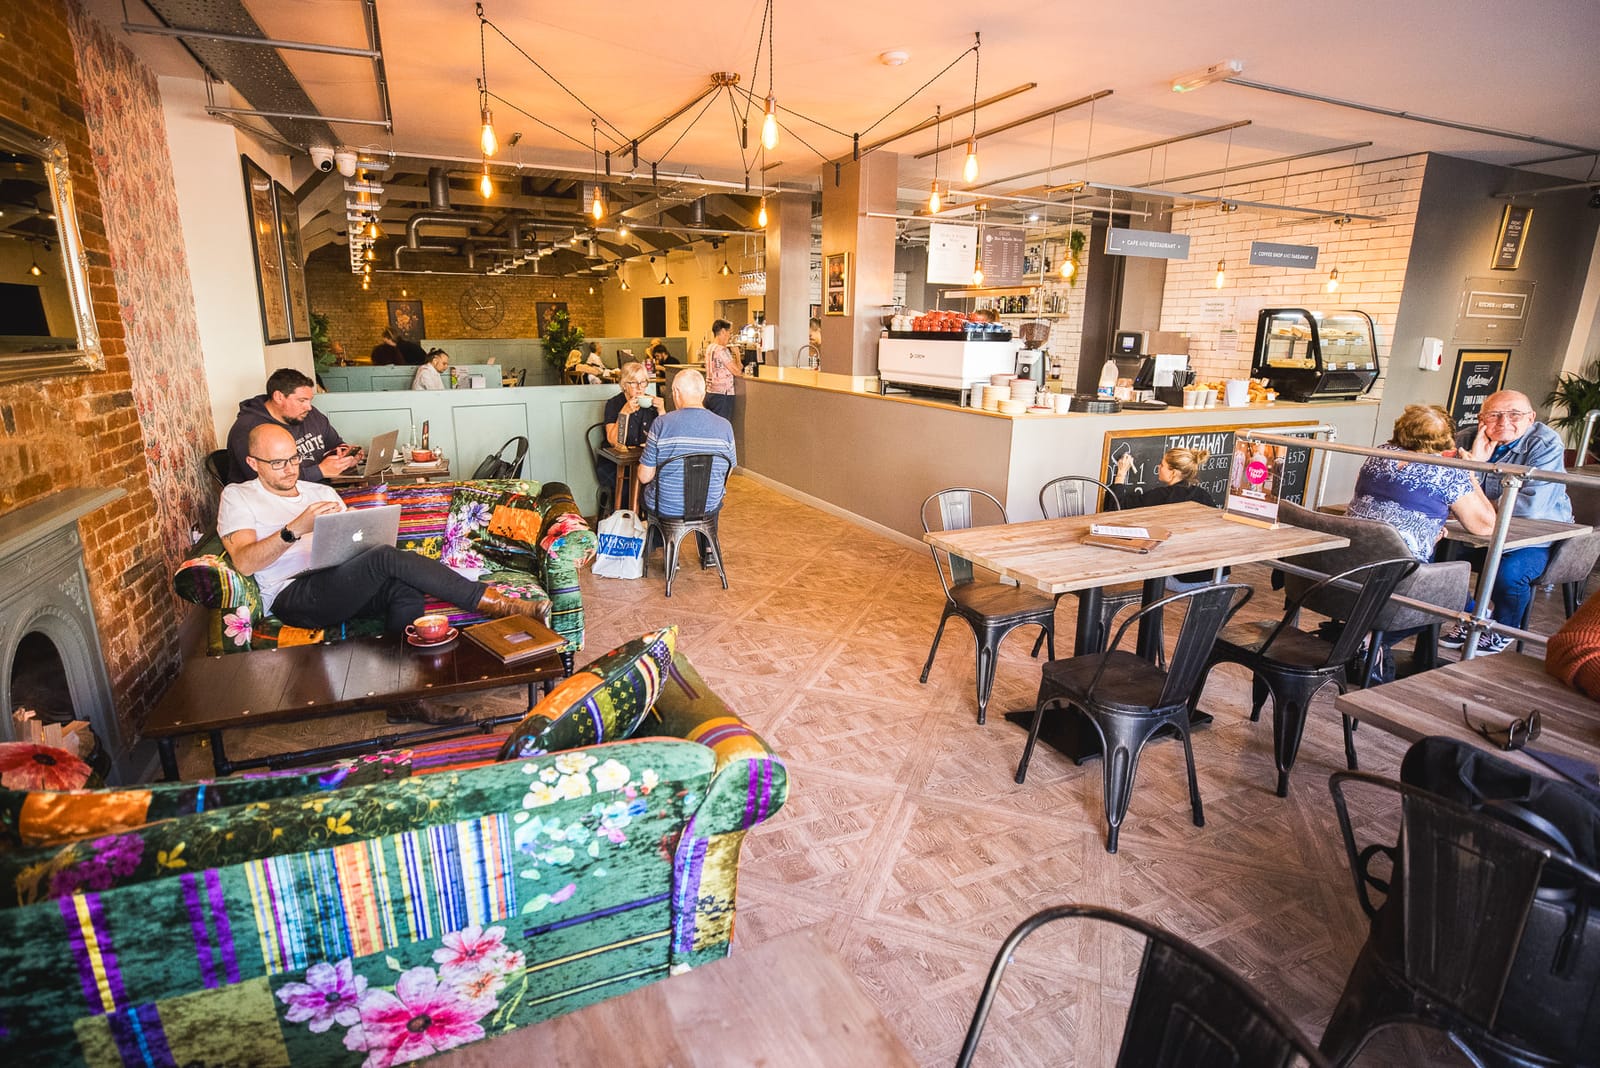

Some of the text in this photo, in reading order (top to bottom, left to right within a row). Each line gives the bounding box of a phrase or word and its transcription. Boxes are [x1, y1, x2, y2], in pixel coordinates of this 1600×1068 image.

[1149, 241, 1177, 249] RESTAURANT
[1169, 433, 1229, 455] TAKEAWAY
[1208, 458, 1216, 471] &
[1136, 463, 1146, 485] 1
[1212, 478, 1228, 493] HOT
